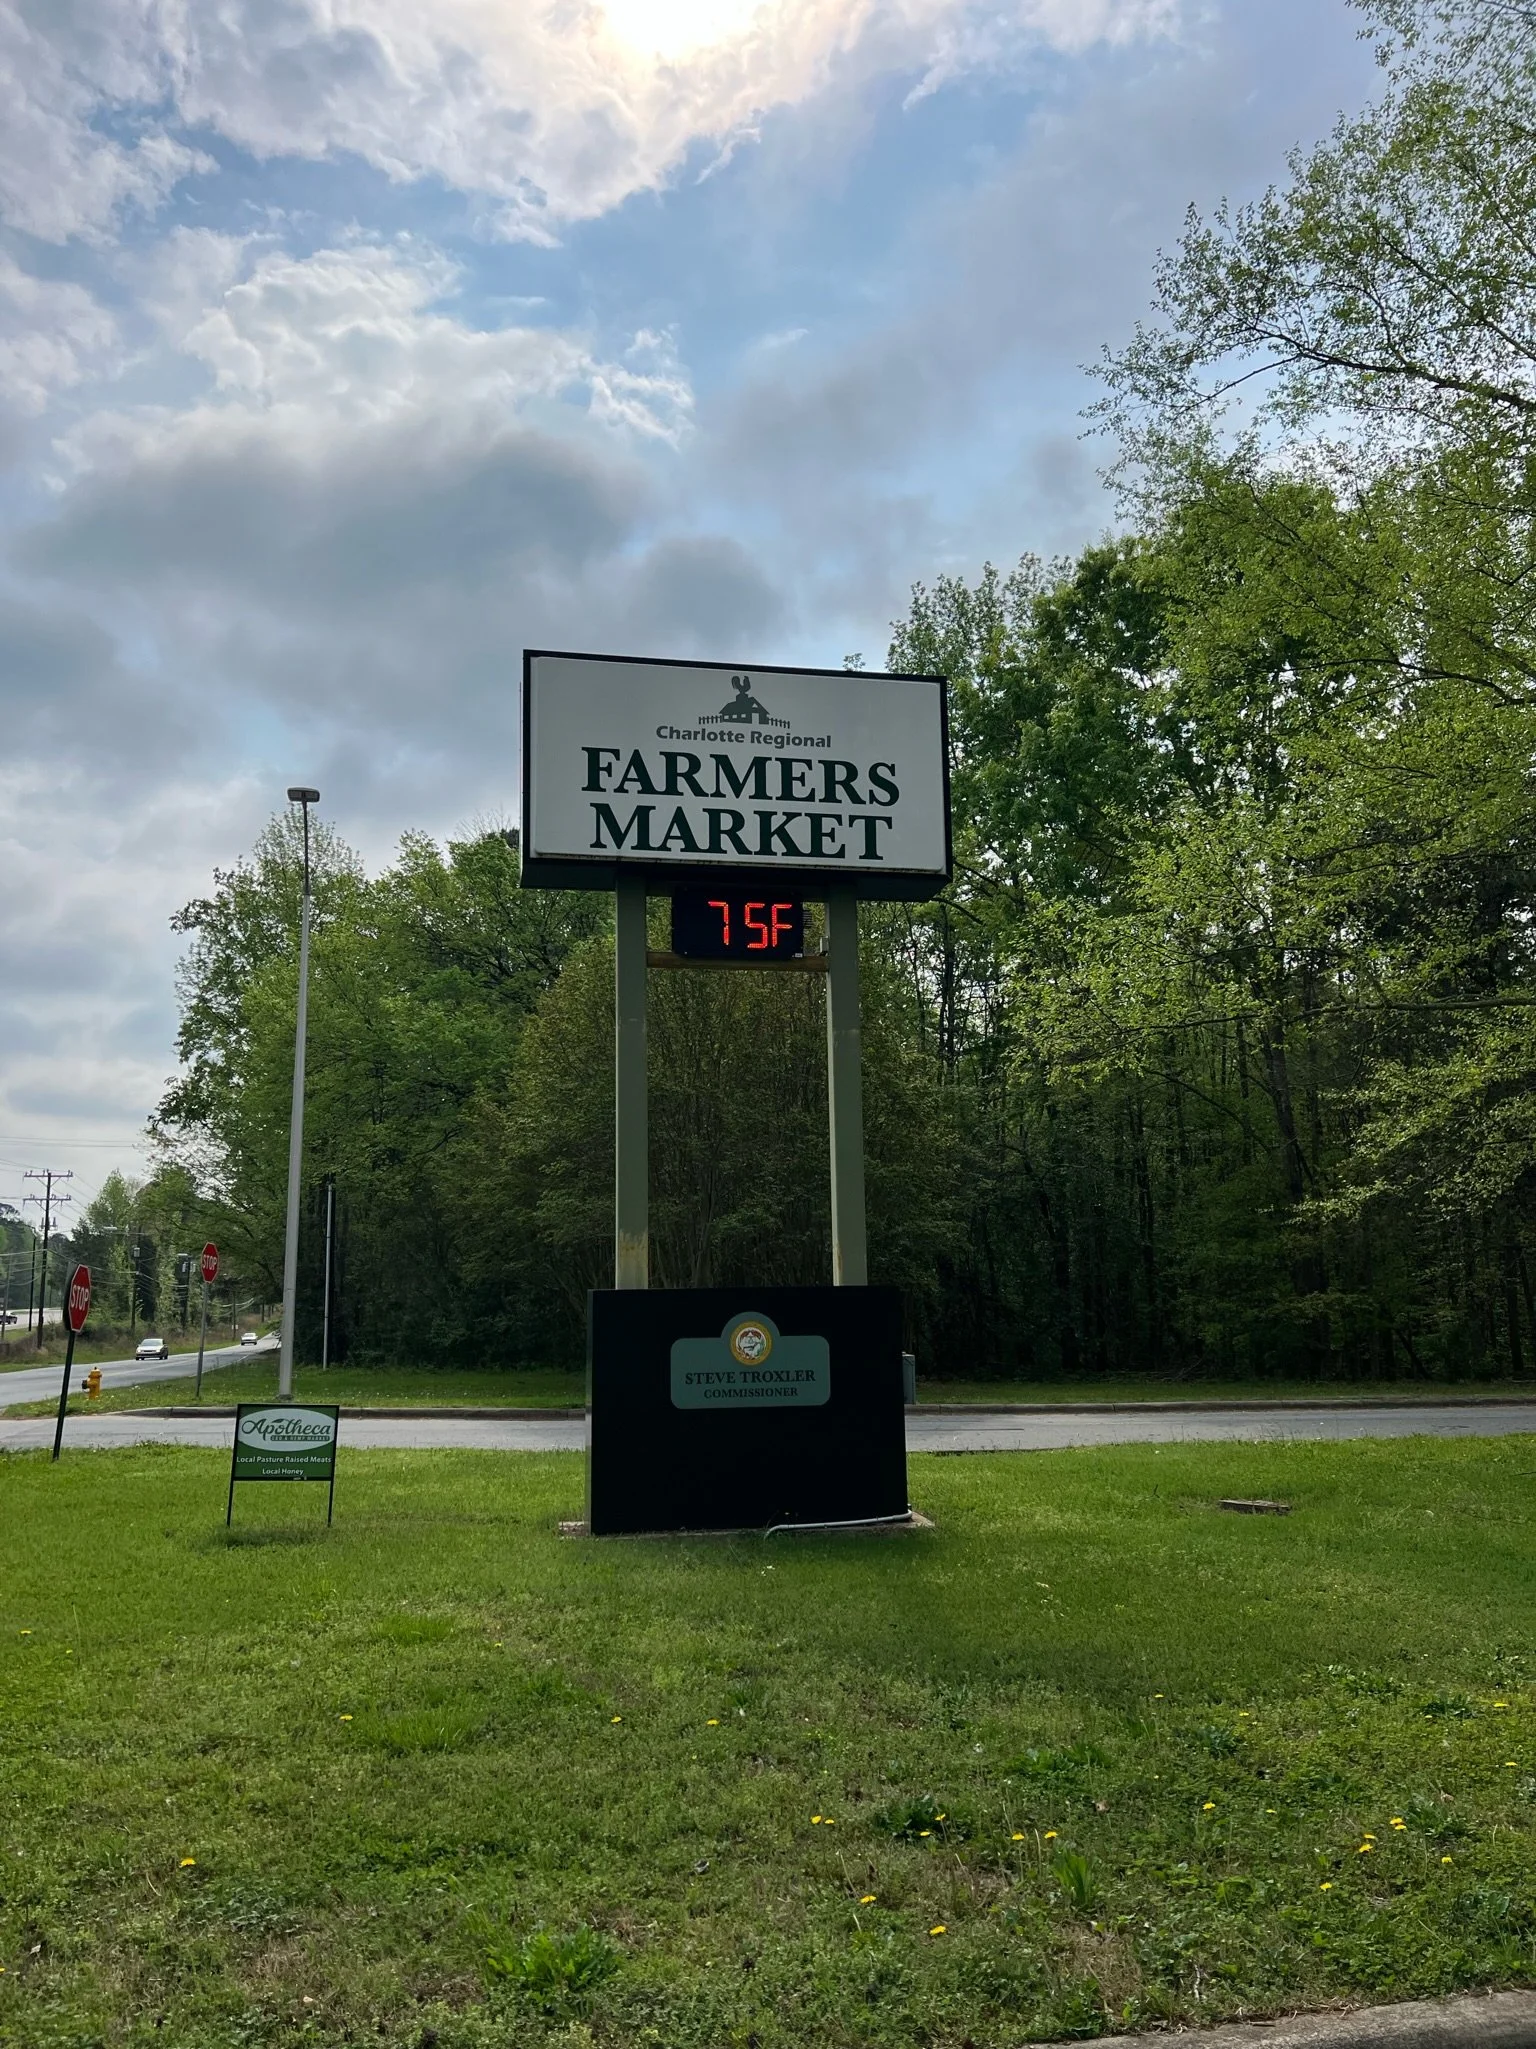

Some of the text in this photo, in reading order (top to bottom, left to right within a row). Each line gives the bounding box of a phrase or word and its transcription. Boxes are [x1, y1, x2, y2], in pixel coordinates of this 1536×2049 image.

[656, 725, 832, 749] Charlotte Regional
[581, 746, 900, 807] FARMERS
[589, 802, 893, 860] MARKET
[708, 901, 792, 948] 75F
[202, 1254, 217, 1270] STOP
[70, 1284, 90, 1310] STOP
[685, 1369, 816, 1385] STEVE TROXLER
[703, 1387, 798, 1399] COMMISSIONER
[241, 1418, 331, 1442] Apotheca
